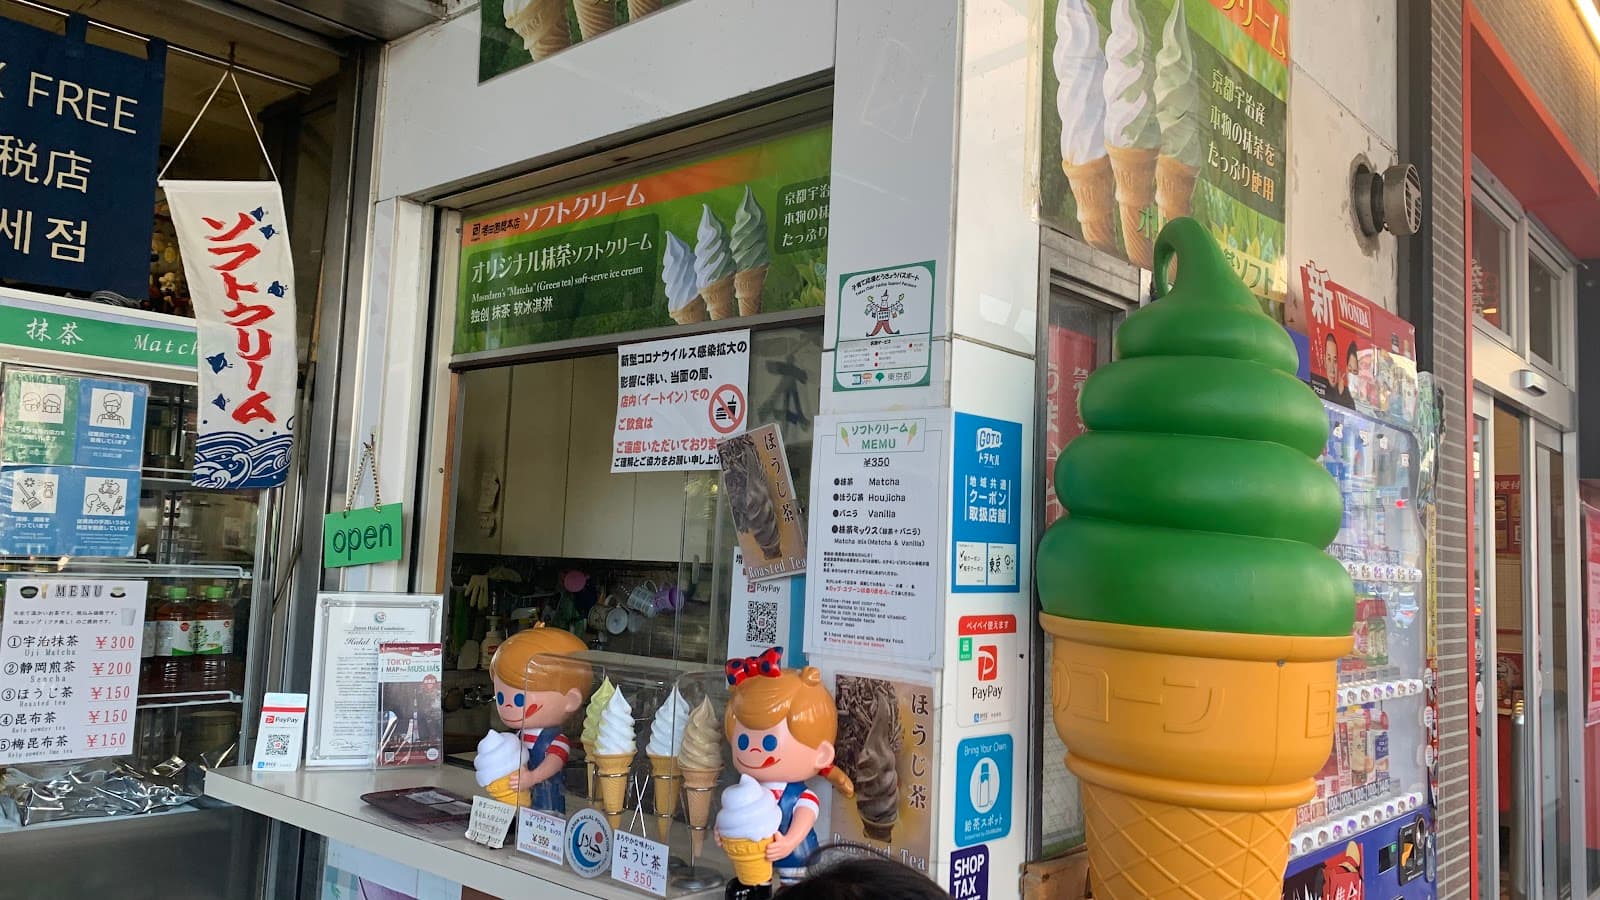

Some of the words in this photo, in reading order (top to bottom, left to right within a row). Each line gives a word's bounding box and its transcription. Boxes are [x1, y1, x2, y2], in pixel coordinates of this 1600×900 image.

[28, 72, 138, 134] FREE
[1211, 68, 1265, 127] 京都宇治産
[1209, 104, 1275, 167] 本物の抹茶を
[0, 135, 92, 193] 税店
[1207, 141, 1275, 202] たっぷり使用
[523, 183, 646, 231] ソフトクリーム
[0, 208, 88, 264] 세점
[782, 226, 828, 247] たっぷり
[471, 232, 652, 284] オリジナル抹茶ソフトクリーム
[609, 269, 620, 278] ice
[620, 265, 643, 277] cream
[1306, 262, 1335, 330] 新
[201, 212, 277, 425] ソフトクリーム
[1336, 291, 1369, 329] WONDA
[26, 317, 84, 346] 抹茶
[621, 340, 747, 367] 新型コロナウイルス感染拡大の
[620, 367, 713, 389] 影響に伴い、当面の間、
[618, 417, 654, 431] ご飲食は
[851, 423, 909, 435] ソフトクリーム
[861, 439, 896, 449] MEMU
[863, 457, 890, 467] ¥350
[978, 452, 1000, 466] トラベル
[763, 432, 794, 522] ほうじ茶
[868, 478, 900, 486] Matcha
[969, 475, 1007, 491] 地域共通
[868, 493, 906, 502] Houjicha
[969, 488, 1007, 506] クーポン
[868, 509, 896, 518] Vanilla
[969, 505, 1007, 524] 取扱店舗
[332, 523, 393, 560] open
[748, 560, 785, 579] Roasted
[789, 556, 806, 570] Tea
[55, 584, 104, 598] MENU
[757, 584, 781, 594] PayPay
[966, 621, 1009, 631] ペイペイ使えます
[407, 664, 440, 672] MUSLIMS
[972, 685, 1003, 701] PayPay
[910, 694, 929, 809] ほうじ茶
[964, 744, 978, 756] Bring
[979, 743, 992, 753] Your
[993, 742, 1007, 752] Own
[965, 813, 1002, 832] 給茶スポット
[616, 833, 655, 851] まろやかな味わい
[620, 845, 661, 870] ほうじ茶
[900, 848, 926, 871] Tea
[954, 854, 985, 878] SHOP
[623, 866, 652, 887] ¥350
[954, 876, 976, 899] TAX
